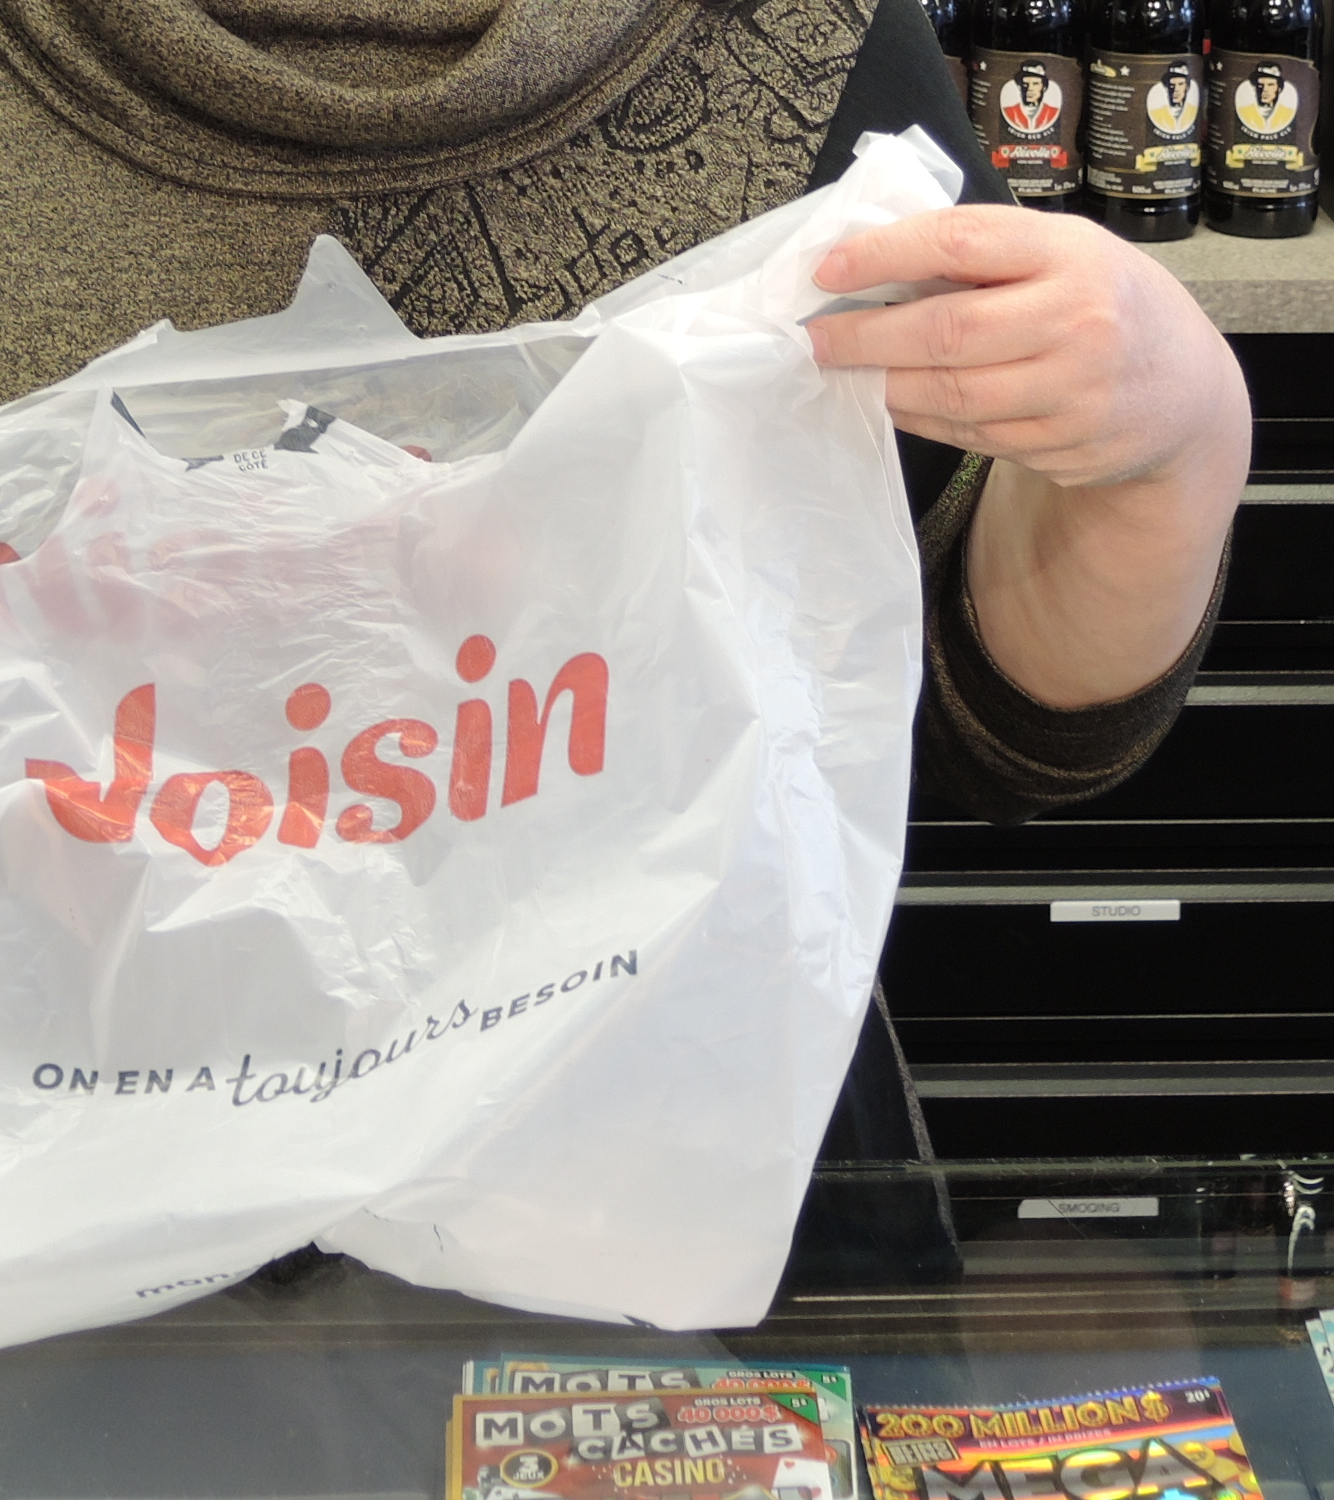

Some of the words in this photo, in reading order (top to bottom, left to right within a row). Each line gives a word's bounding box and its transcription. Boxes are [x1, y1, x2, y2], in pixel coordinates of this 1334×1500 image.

[1091, 905, 1141, 918] STUDIO
[31, 1062, 101, 1095] ON
[113, 1067, 174, 1095] EN
[185, 1066, 216, 1092] A
[225, 999, 480, 1107] toujours
[479, 947, 641, 1033] BESOIN
[677, 1406, 710, 1423] 40
[694, 1398, 726, 1408] GROS
[728, 1398, 761, 1408] LOTS
[475, 1399, 664, 1447] MOTS
[875, 1412, 965, 1439] 200
[576, 1425, 804, 1461] CACHÉS
[613, 1458, 724, 1489] CASINO
